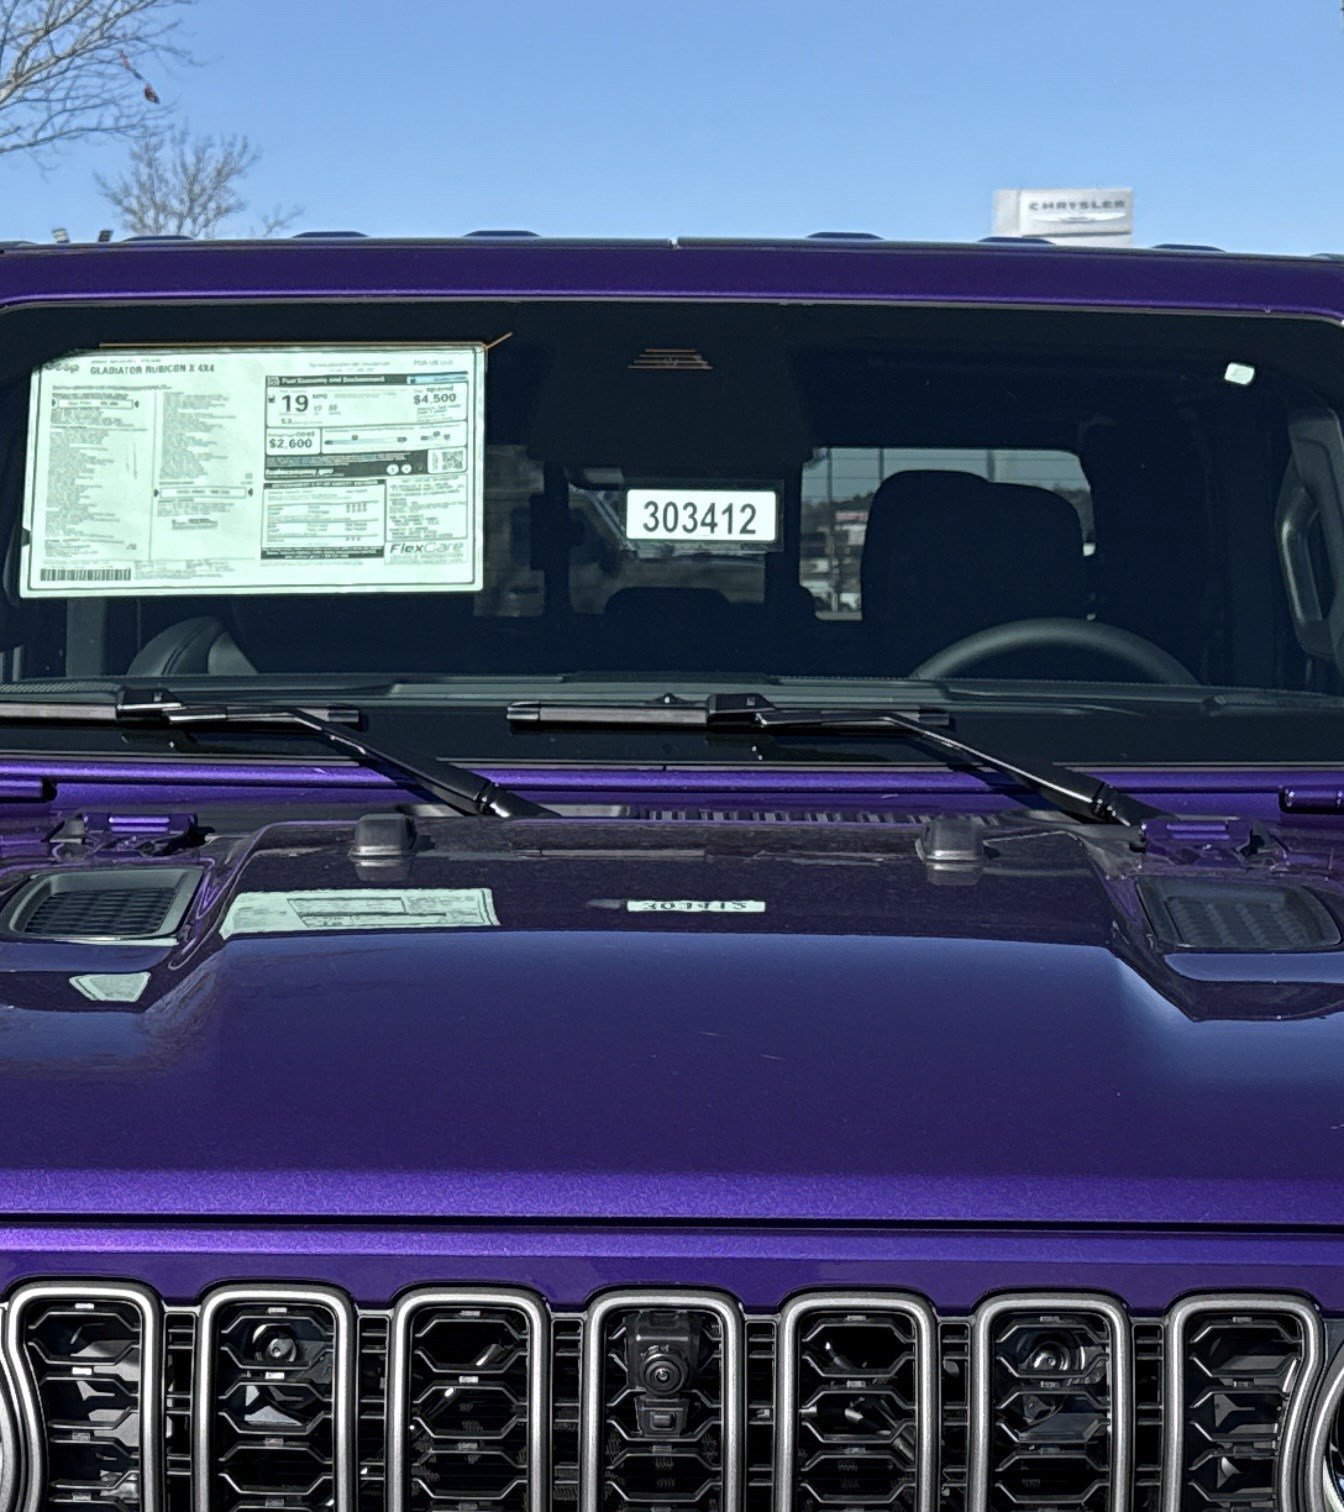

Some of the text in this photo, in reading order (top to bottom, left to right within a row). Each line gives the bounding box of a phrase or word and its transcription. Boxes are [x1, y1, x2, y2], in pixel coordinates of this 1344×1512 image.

[1028, 199, 1125, 211] CHRYSLER
[281, 394, 309, 412] 19
[643, 500, 757, 535] 303412
